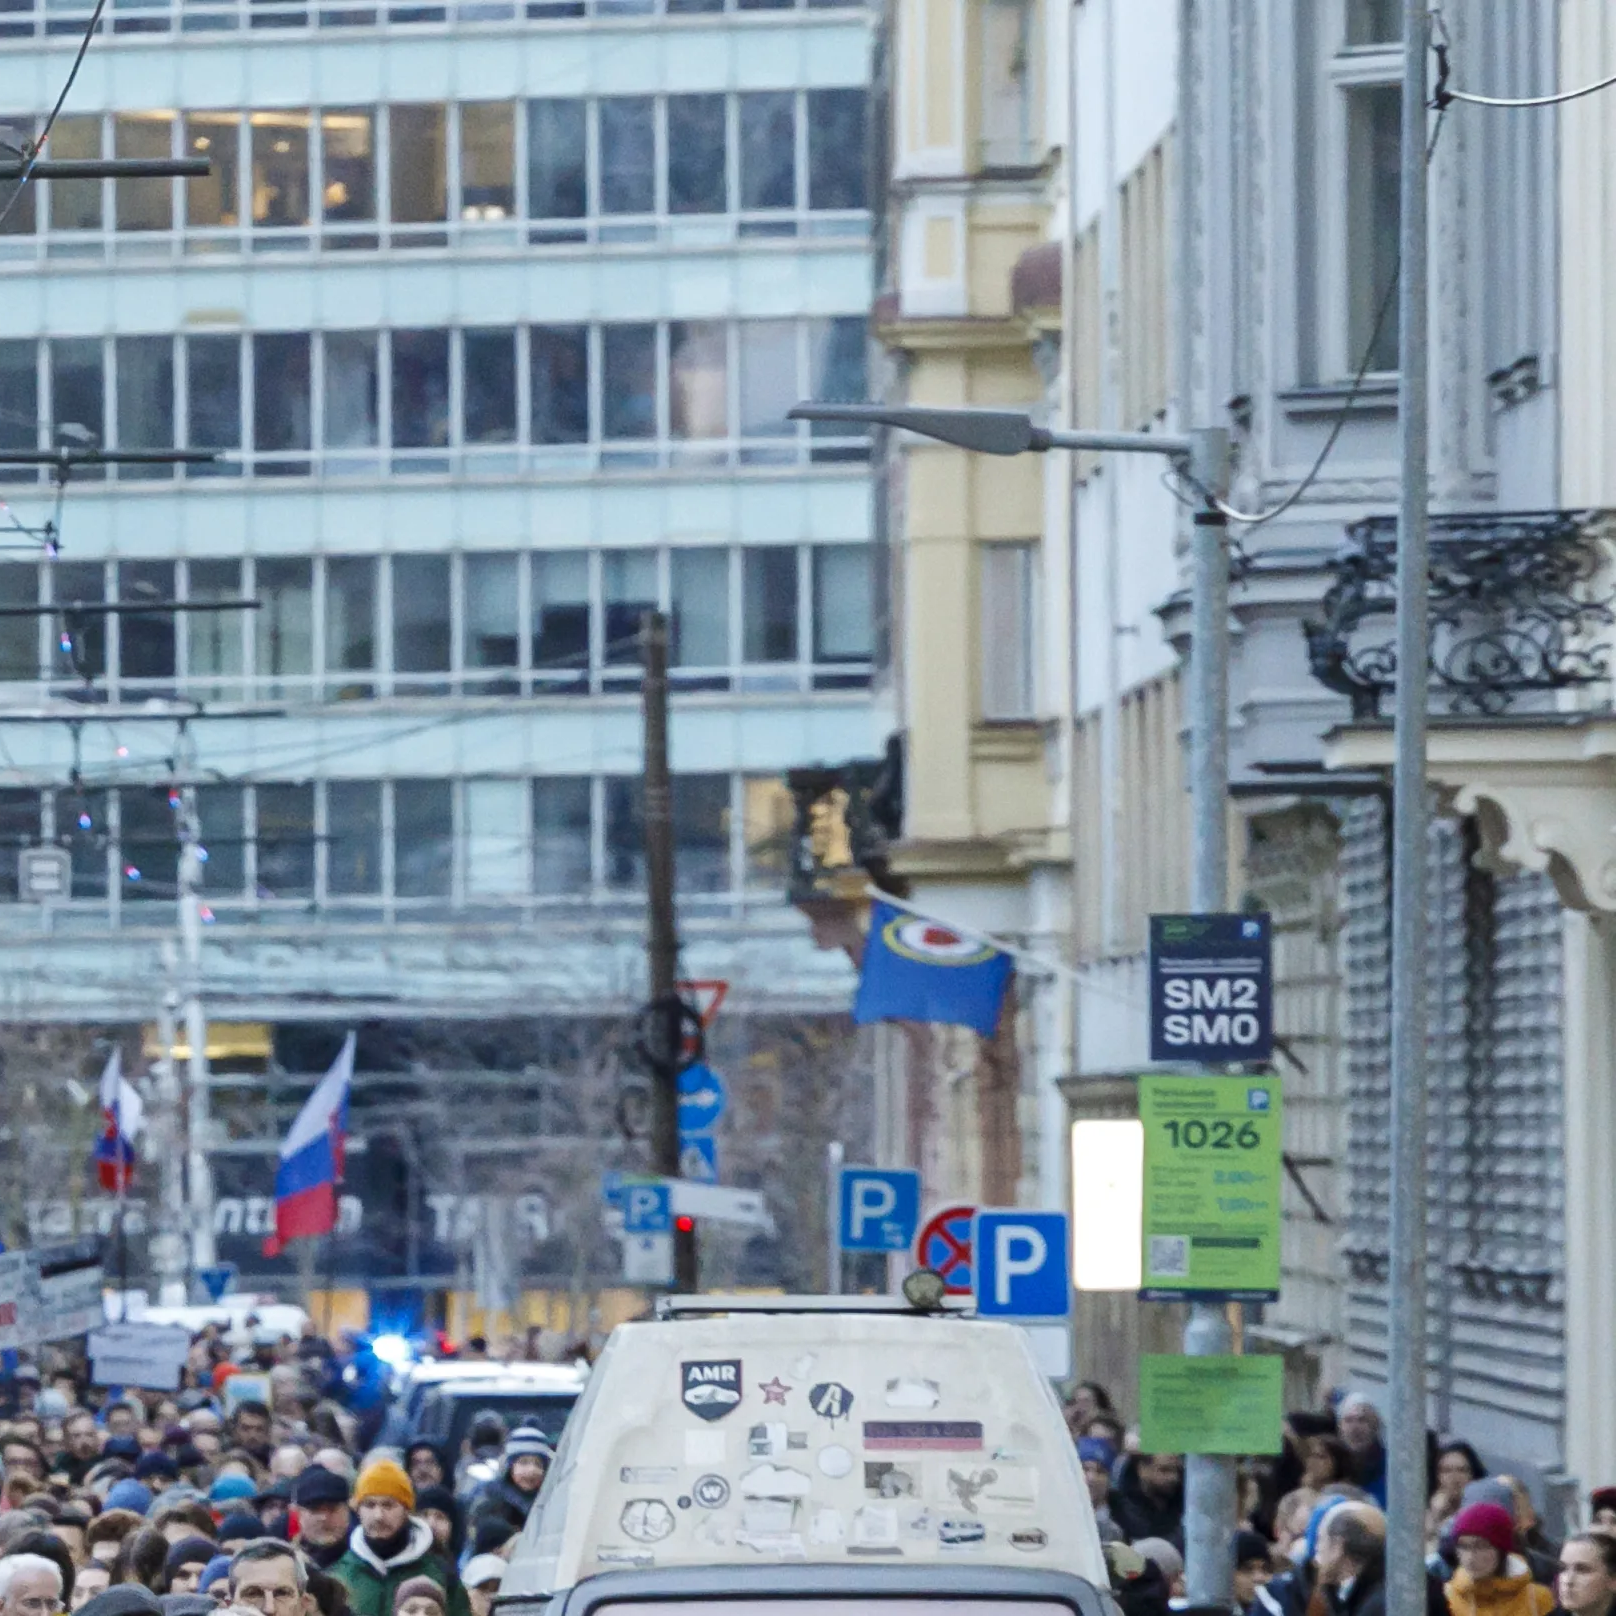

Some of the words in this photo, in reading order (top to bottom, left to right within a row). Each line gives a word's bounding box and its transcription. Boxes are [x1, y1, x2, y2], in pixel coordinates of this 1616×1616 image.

[1163, 978, 1259, 1010] SM2
[1163, 1119, 1261, 1149] 1026
[850, 1179, 896, 1240] P
[995, 1224, 1047, 1304] P
[688, 1365, 736, 1382] AMR
